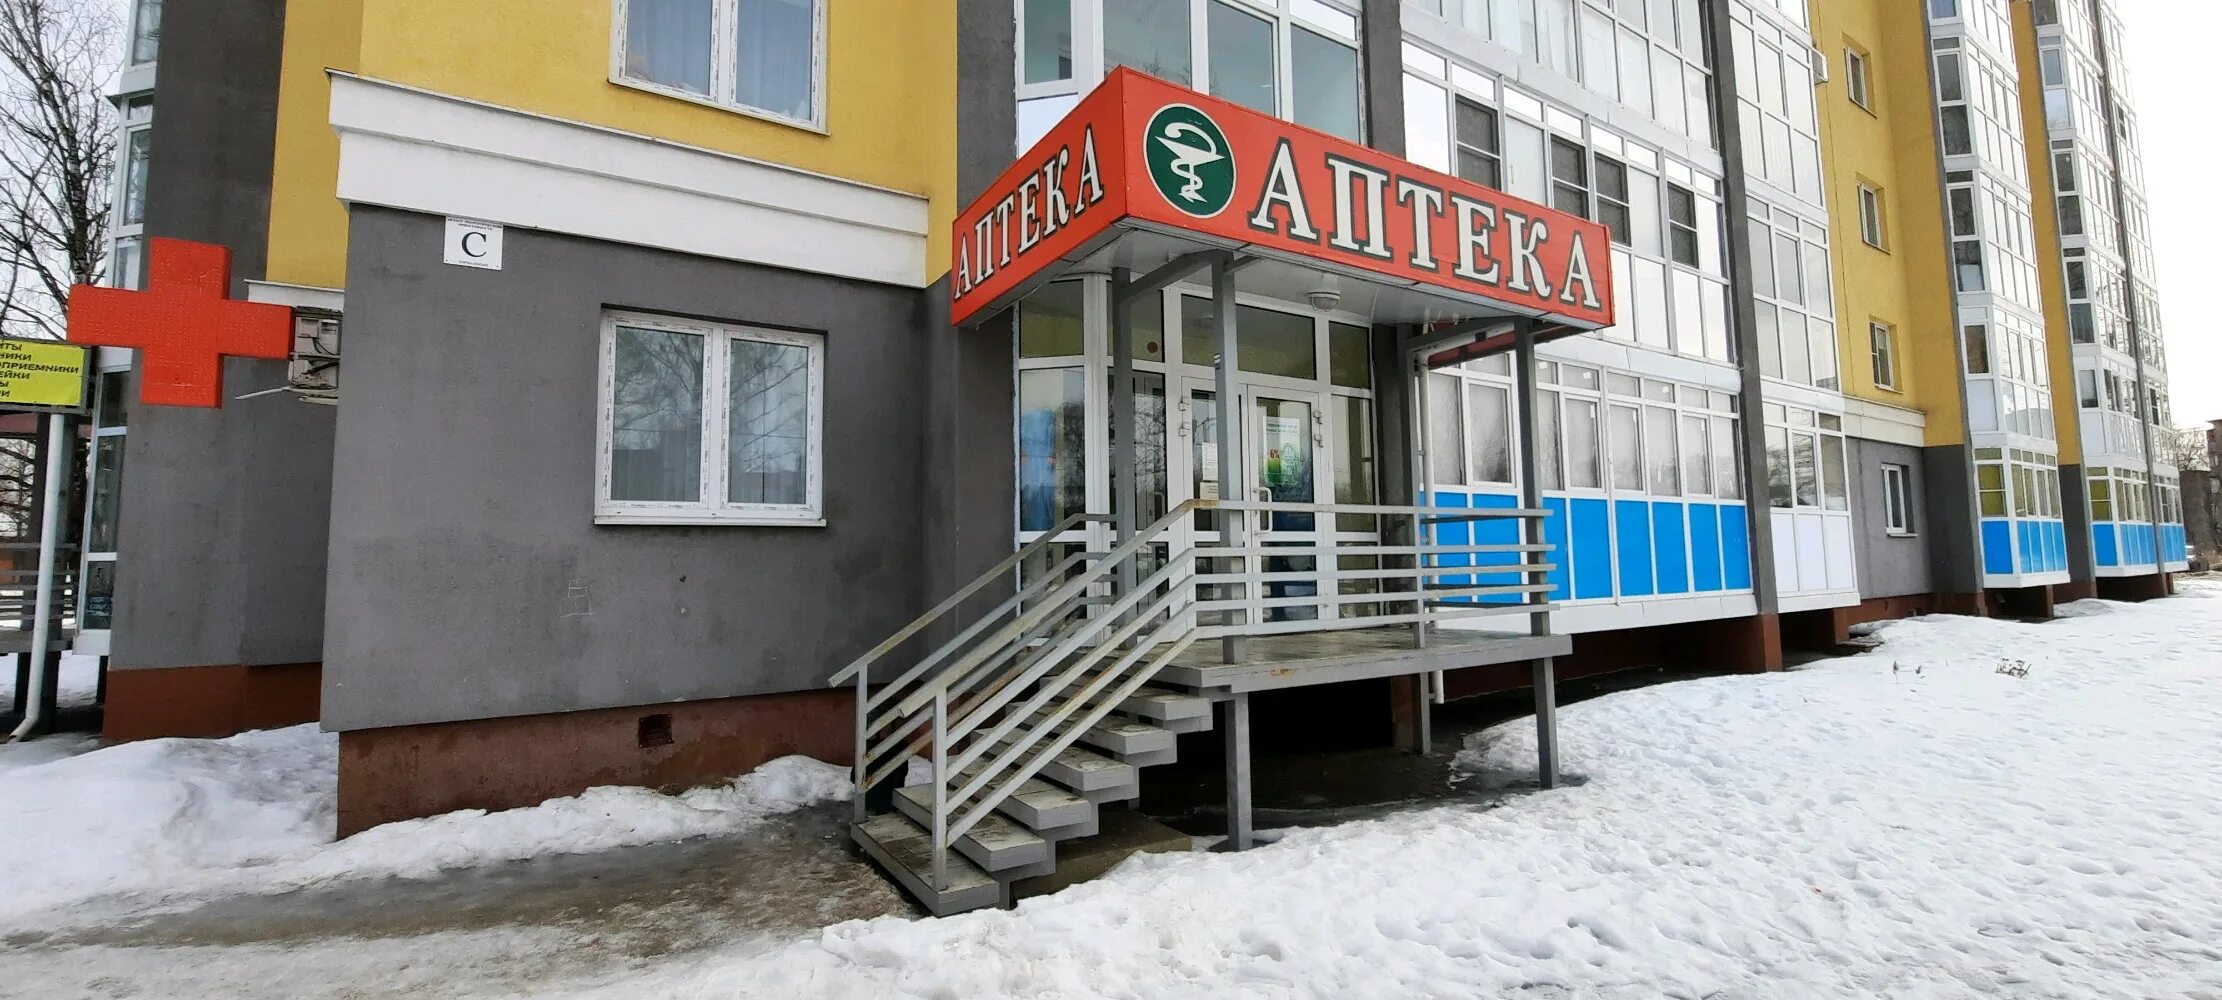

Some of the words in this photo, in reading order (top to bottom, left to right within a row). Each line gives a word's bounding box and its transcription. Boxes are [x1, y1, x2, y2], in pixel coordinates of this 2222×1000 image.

[953, 123, 1104, 302] АПТЕКА
[1248, 136, 1602, 311] АПТЕКА
[0, 361, 79, 374] ПРИЕМНИКИ
